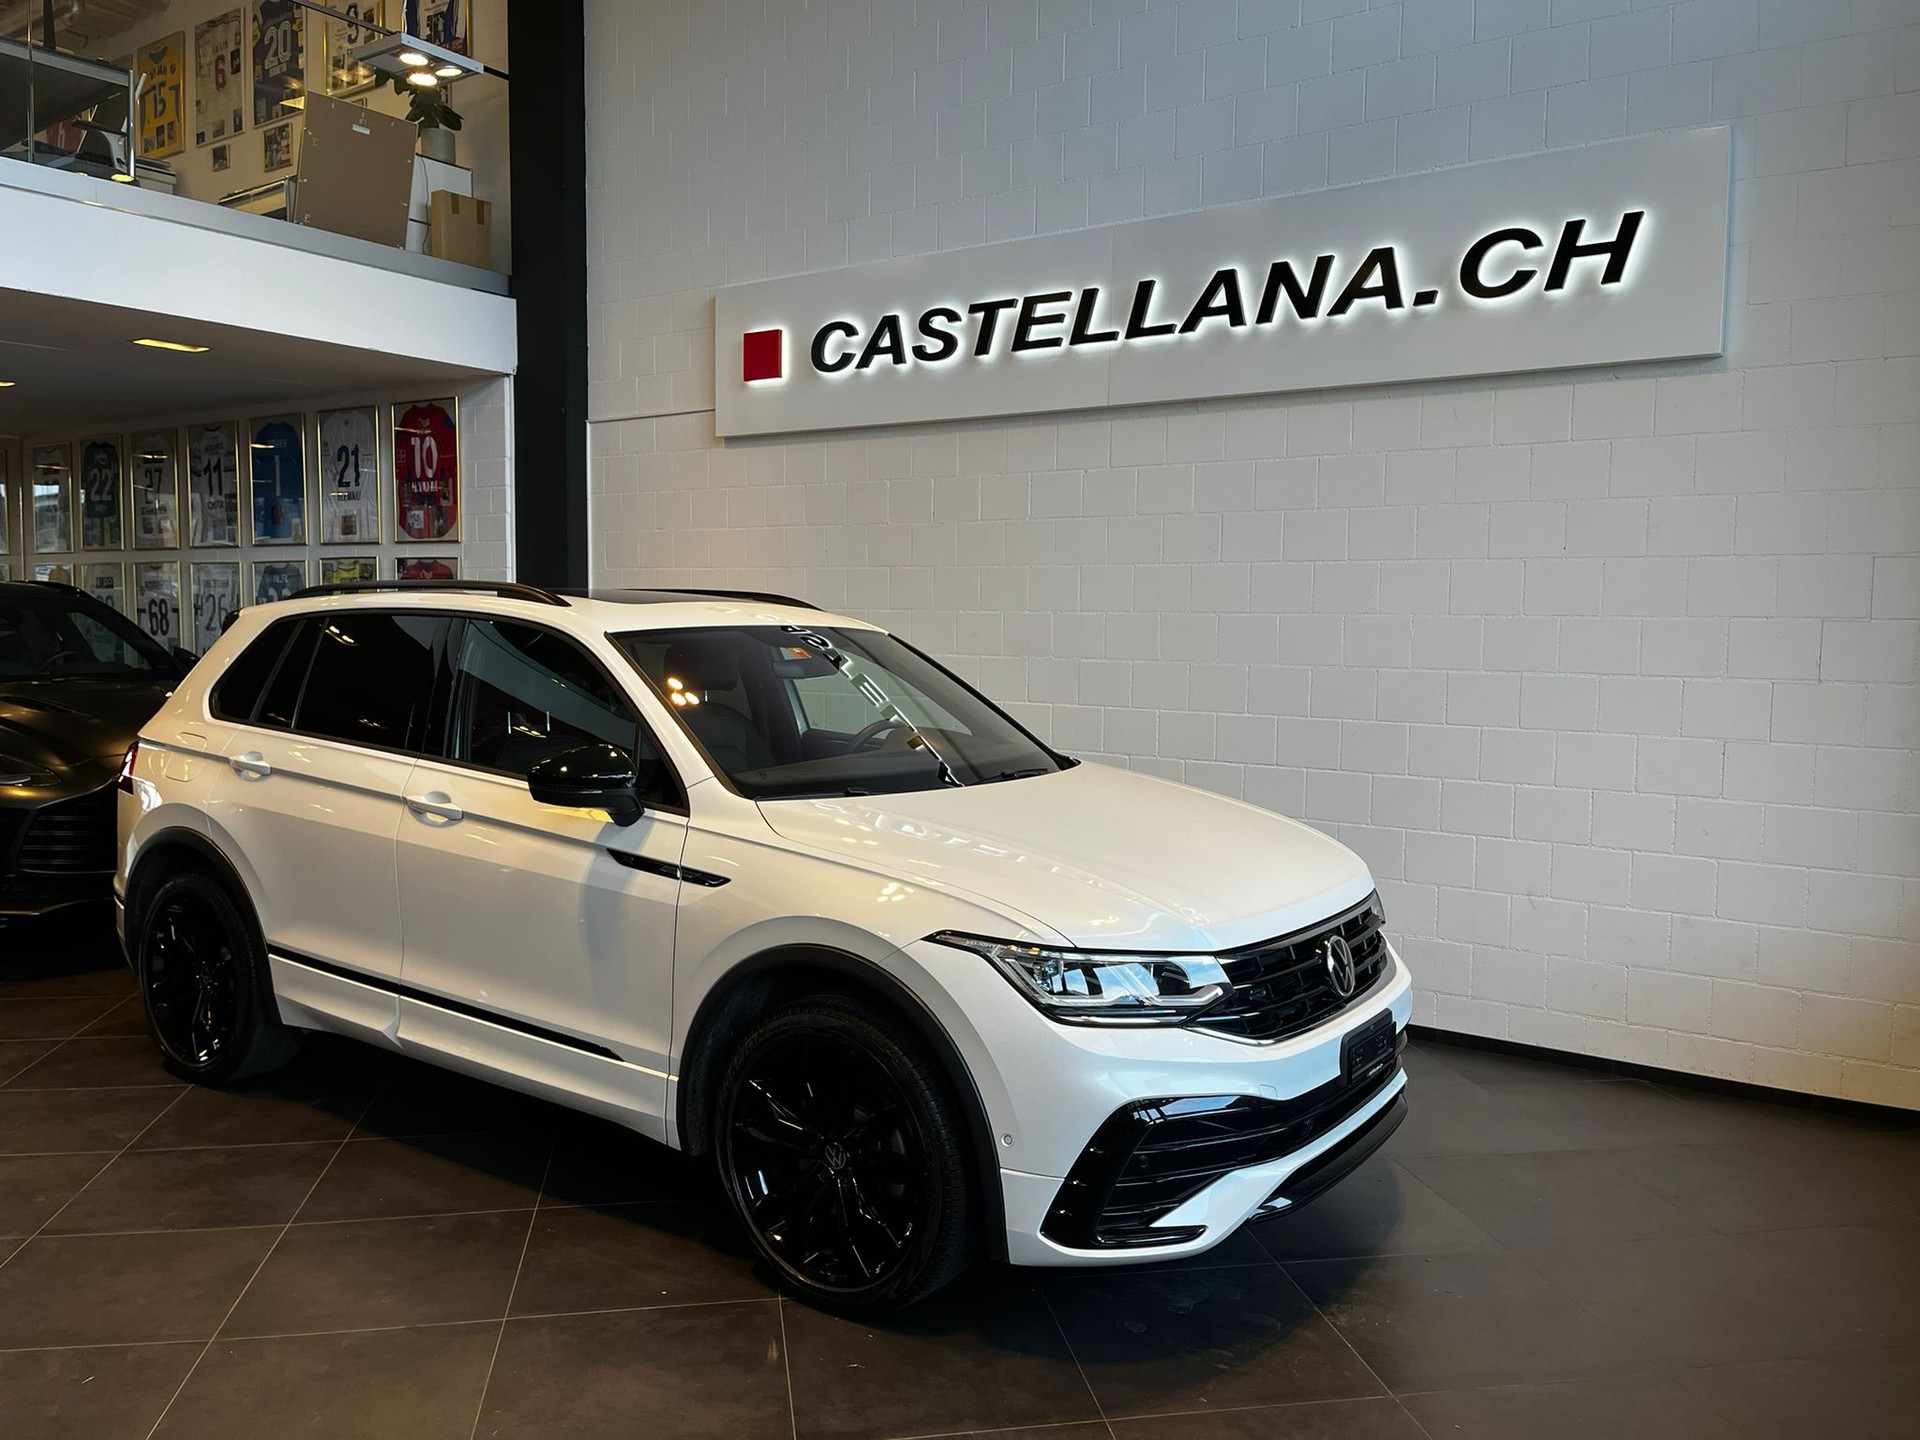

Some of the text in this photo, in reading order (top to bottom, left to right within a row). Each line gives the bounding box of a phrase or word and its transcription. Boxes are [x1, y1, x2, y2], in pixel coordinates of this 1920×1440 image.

[264, 20, 292, 70] 20
[214, 54, 226, 93] 6
[811, 210, 1645, 373] CASTELLANA.CH
[203, 457, 223, 496] 11
[274, 454, 281, 497] 1
[337, 443, 360, 488] 21
[411, 435, 439, 479] 10
[90, 467, 113, 501] 22
[148, 598, 170, 636] 68
